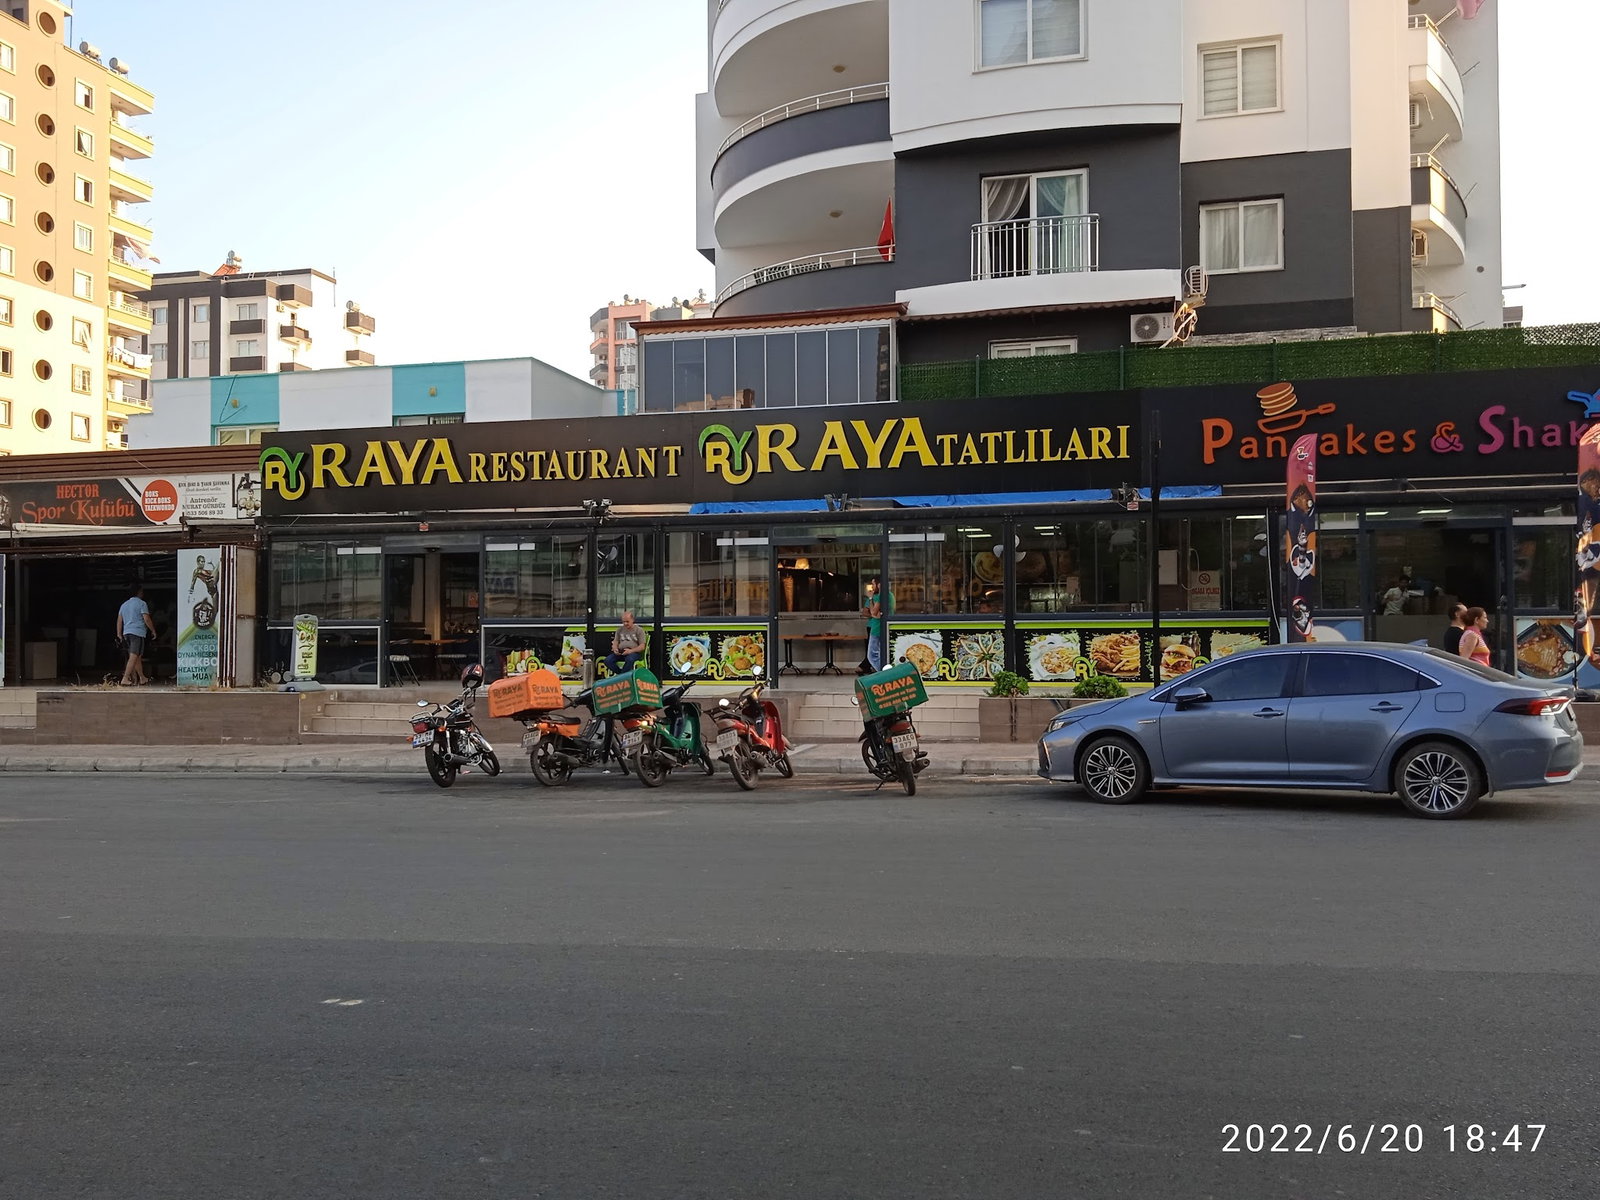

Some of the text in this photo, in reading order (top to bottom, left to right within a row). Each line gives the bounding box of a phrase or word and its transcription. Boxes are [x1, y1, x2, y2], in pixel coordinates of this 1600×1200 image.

[755, 417, 937, 473] RAYA
[937, 425, 1131, 467] TATLILARI
[1202, 417, 1416, 464] Panakes
[1430, 421, 1464, 453] &
[311, 437, 463, 488] RAYA
[468, 445, 682, 483] RESTAURANT
[56, 484, 100, 499] HECTOR
[145, 490, 159, 498] BOKS
[20, 501, 66, 523] Spor
[70, 498, 136, 524] Kulübü
[192, 673, 213, 681] MUAY
[885, 676, 915, 692] RAYA
[606, 680, 631, 694] RAYA
